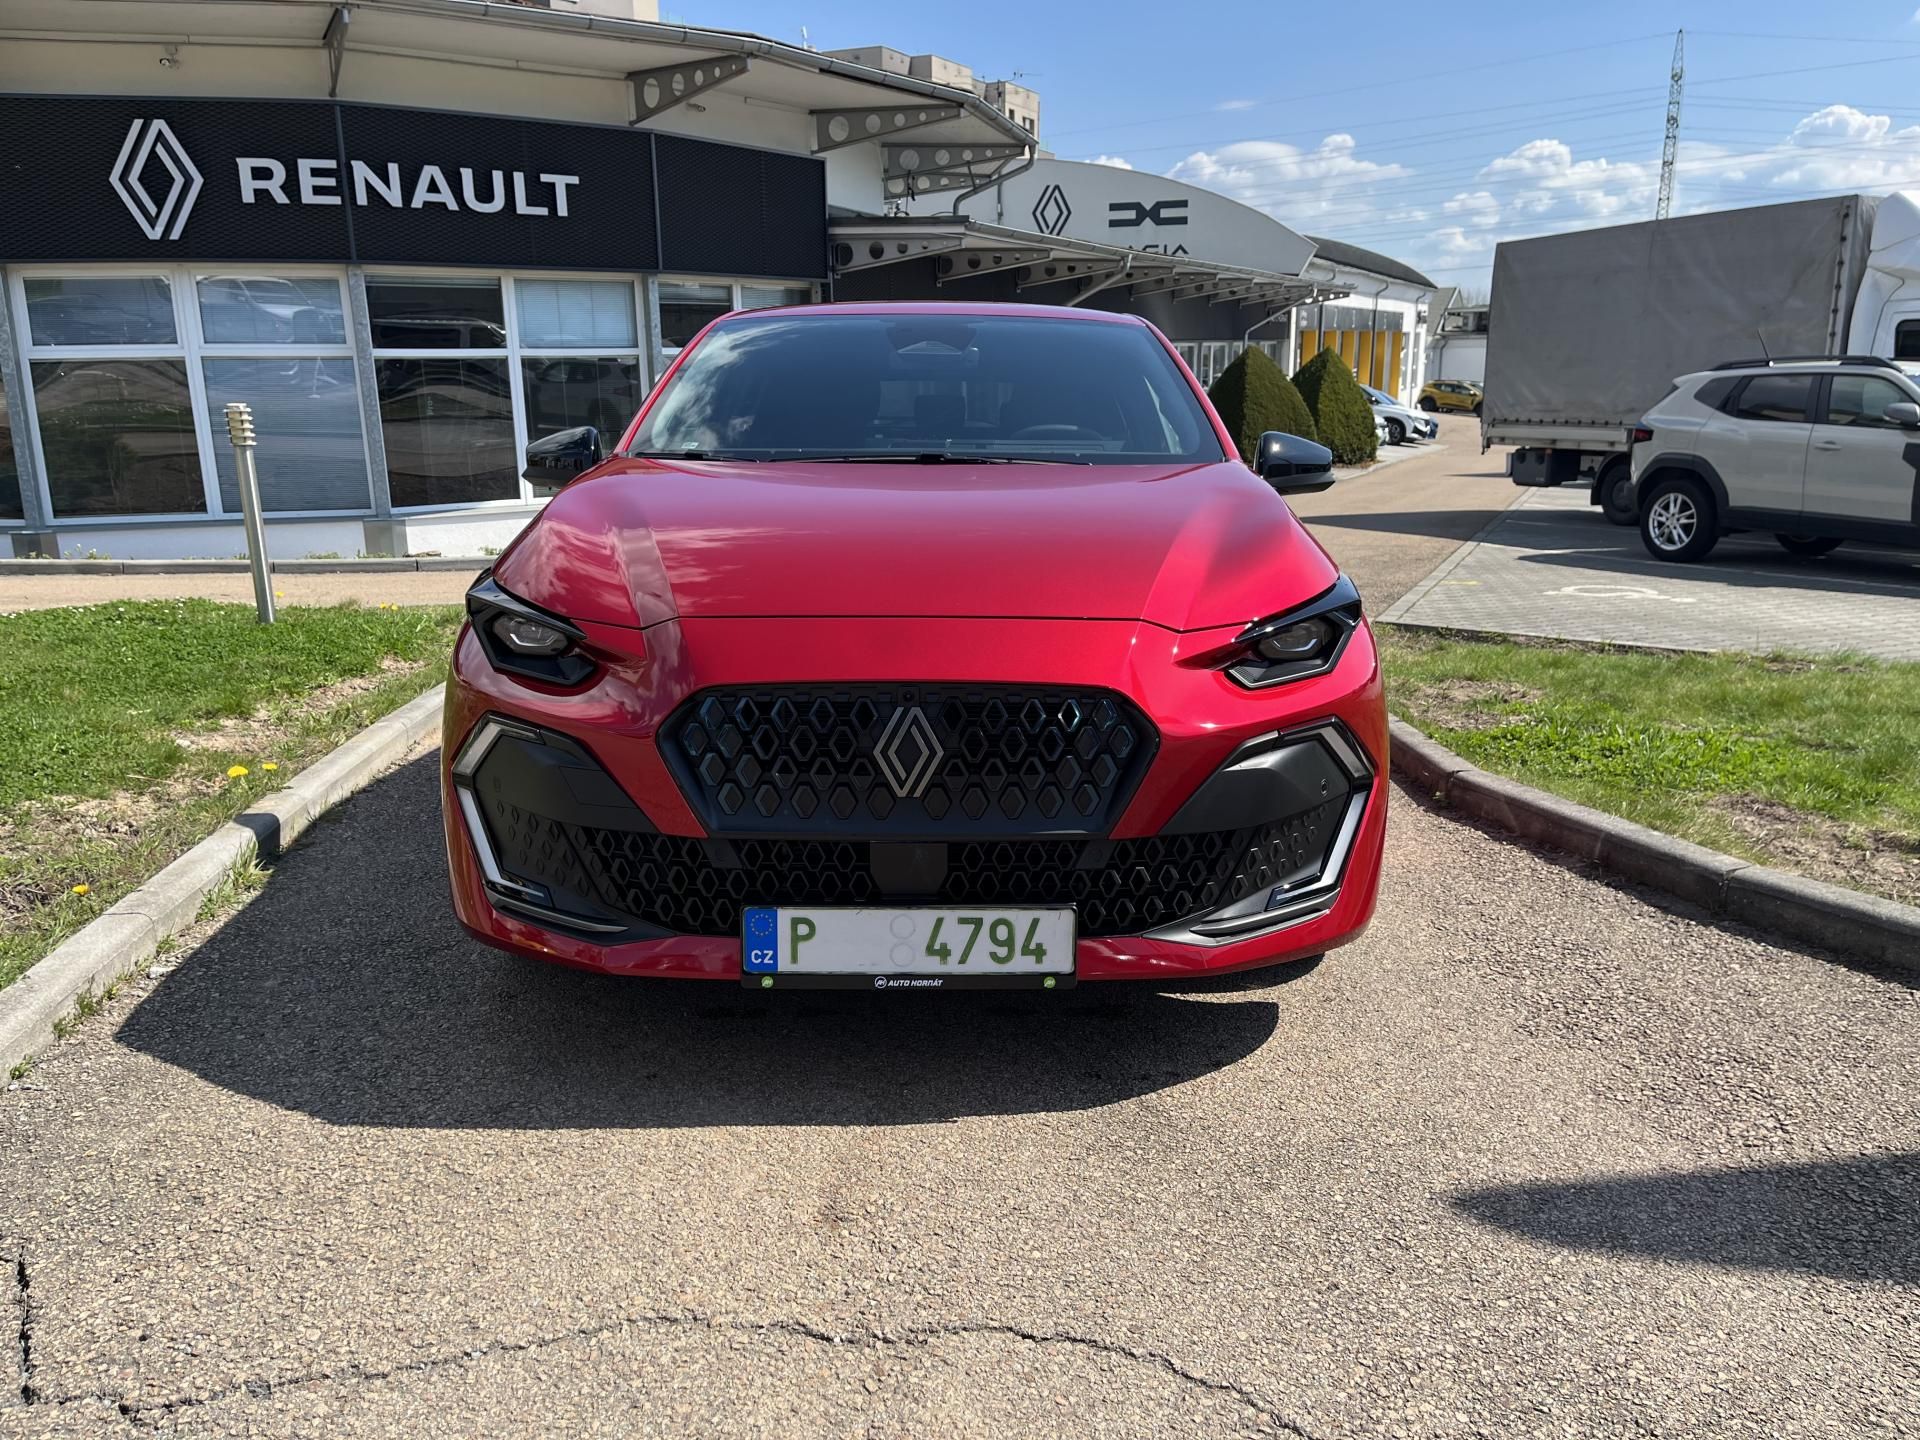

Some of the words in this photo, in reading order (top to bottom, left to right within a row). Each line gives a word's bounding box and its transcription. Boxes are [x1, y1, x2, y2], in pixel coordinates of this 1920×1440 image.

[236, 157, 580, 217] RENAULT
[750, 949, 774, 964] CZ
[925, 916, 1048, 965] 4794
[888, 979, 910, 987] AUTO
[910, 978, 943, 987] HORNÁT
